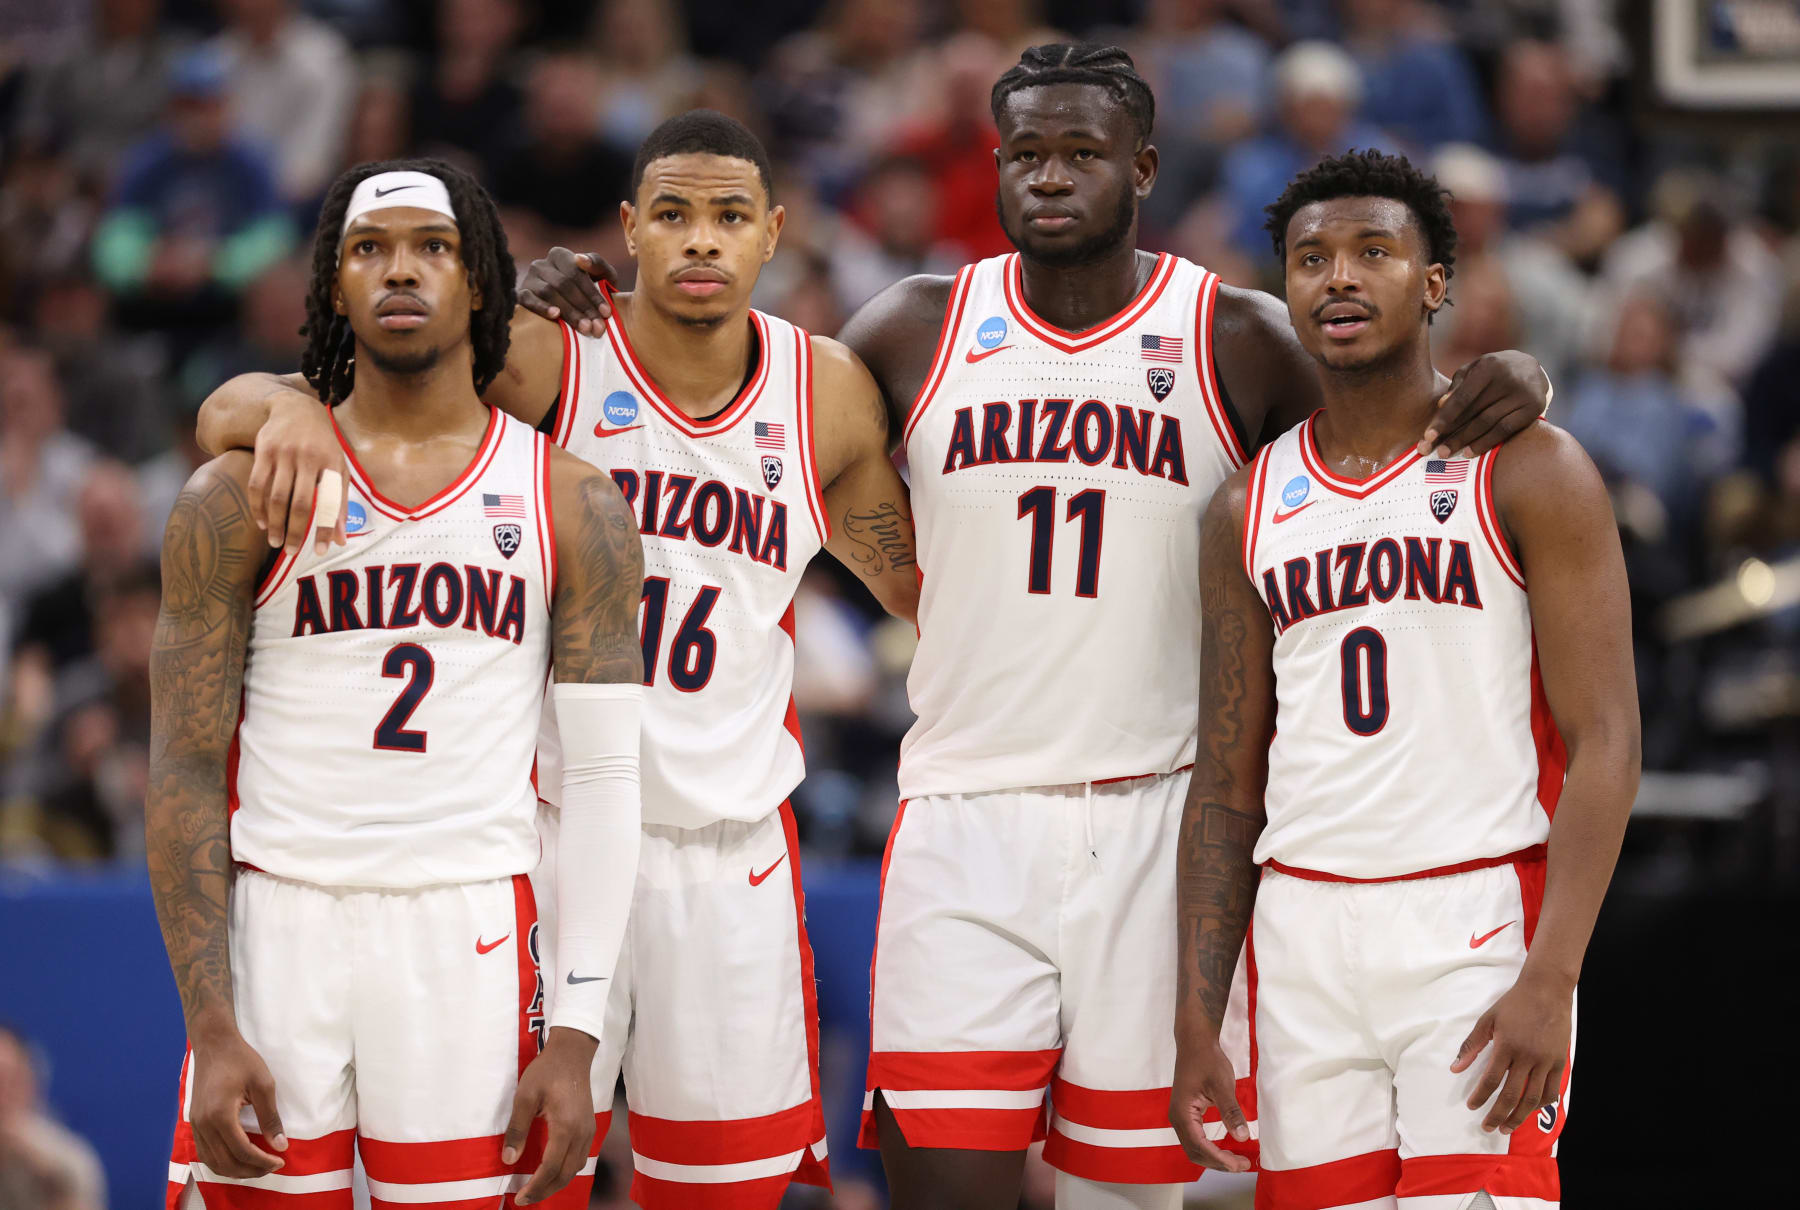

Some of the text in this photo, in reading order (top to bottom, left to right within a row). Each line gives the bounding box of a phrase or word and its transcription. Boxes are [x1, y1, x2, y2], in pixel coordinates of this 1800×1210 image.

[981, 330, 1004, 341] NCAA
[1149, 369, 1174, 388] PAC
[1153, 381, 1167, 394] 12
[607, 406, 636, 417] NCAA
[942, 399, 1189, 487] ARIZONA
[762, 457, 781, 477] PAC
[766, 470, 778, 483] 12
[1285, 487, 1307, 500] NCAA
[1431, 491, 1456, 509] PAC
[1436, 503, 1449, 515] 12
[346, 515, 364, 526] CAA
[610, 469, 788, 573] RIZONA
[495, 525, 520, 545] PAC
[501, 538, 515, 551] 12
[1017, 485, 1106, 598] 11
[1263, 536, 1483, 636] ARIZONA
[291, 562, 526, 646] ARIZONA
[640, 575, 722, 693] 16
[1341, 626, 1390, 737] 0
[373, 642, 435, 753] 2
